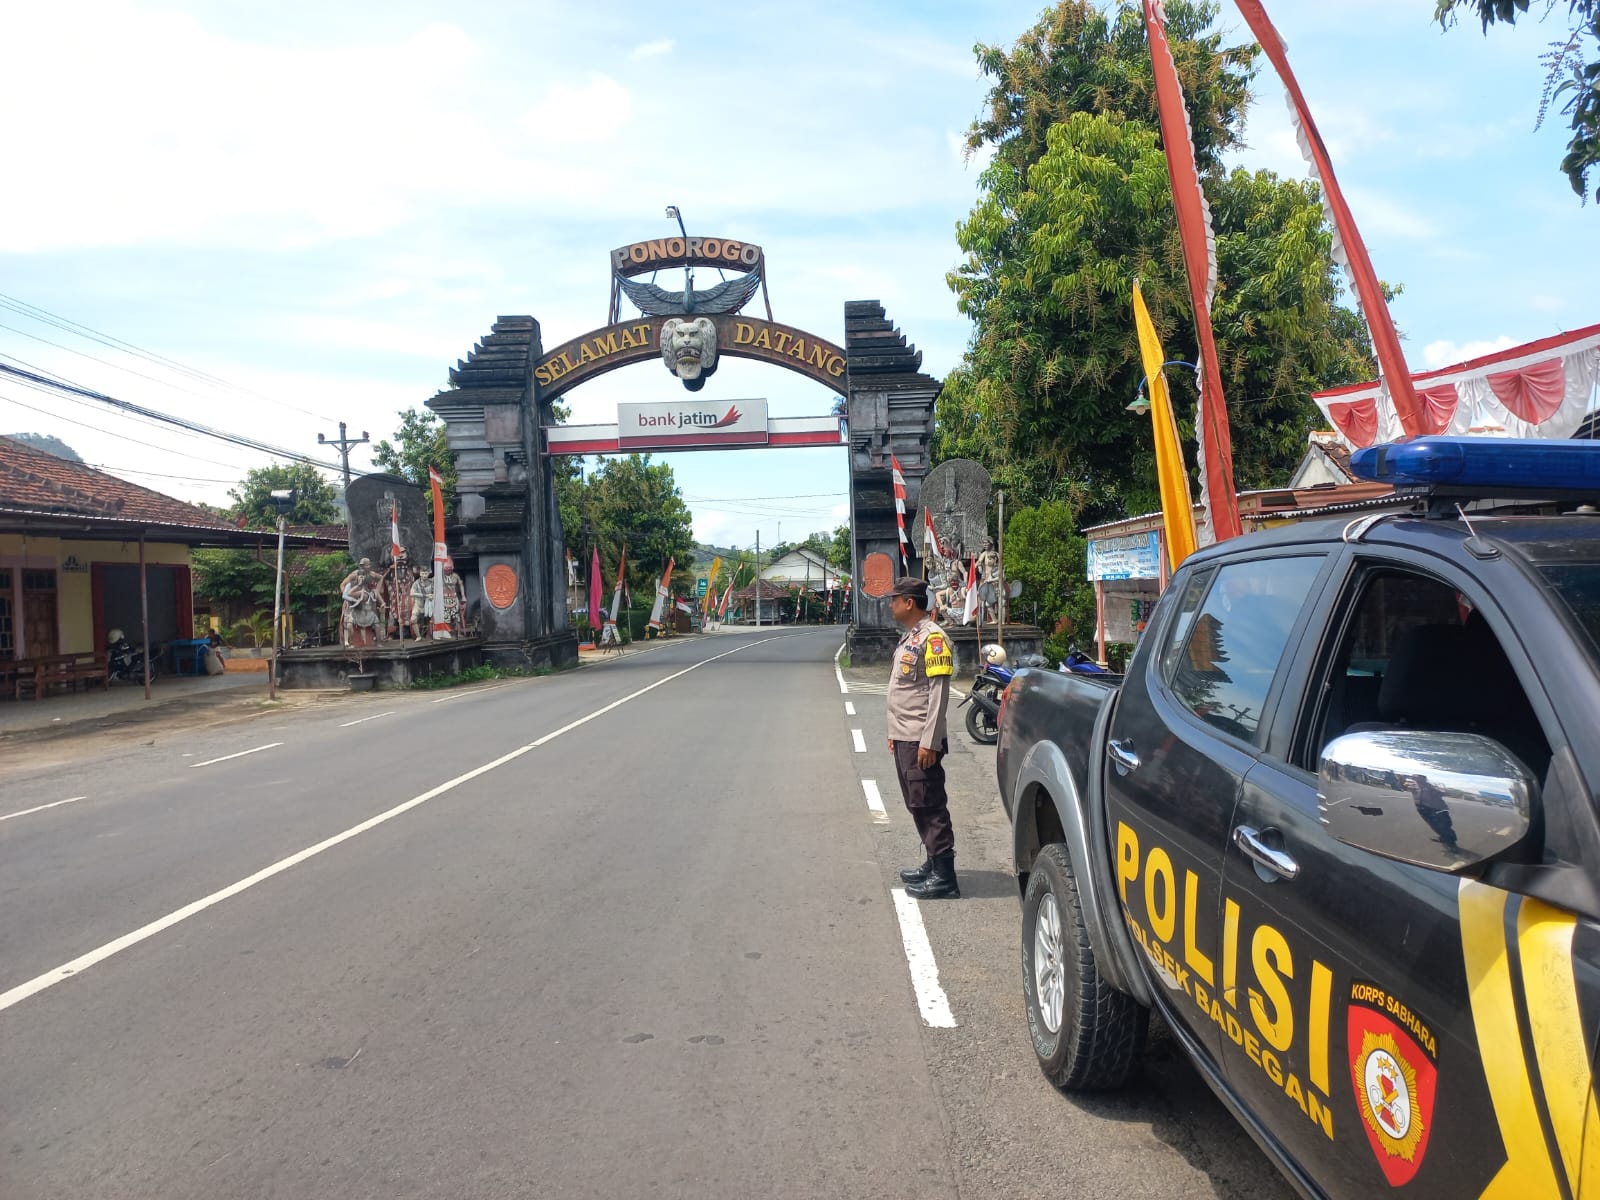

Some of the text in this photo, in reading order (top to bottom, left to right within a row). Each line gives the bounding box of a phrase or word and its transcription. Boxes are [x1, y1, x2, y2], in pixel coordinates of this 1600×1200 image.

[614, 238, 761, 269] PONOROGO
[534, 323, 847, 387] SELAMAT DATANG
[638, 411, 718, 429] bank jatim
[1117, 820, 1334, 1098] POLISI
[1123, 909, 1191, 997] POLSEK
[1195, 980, 1335, 1142] BADEGAN
[1351, 983, 1437, 1060] KORPS SABHARA
